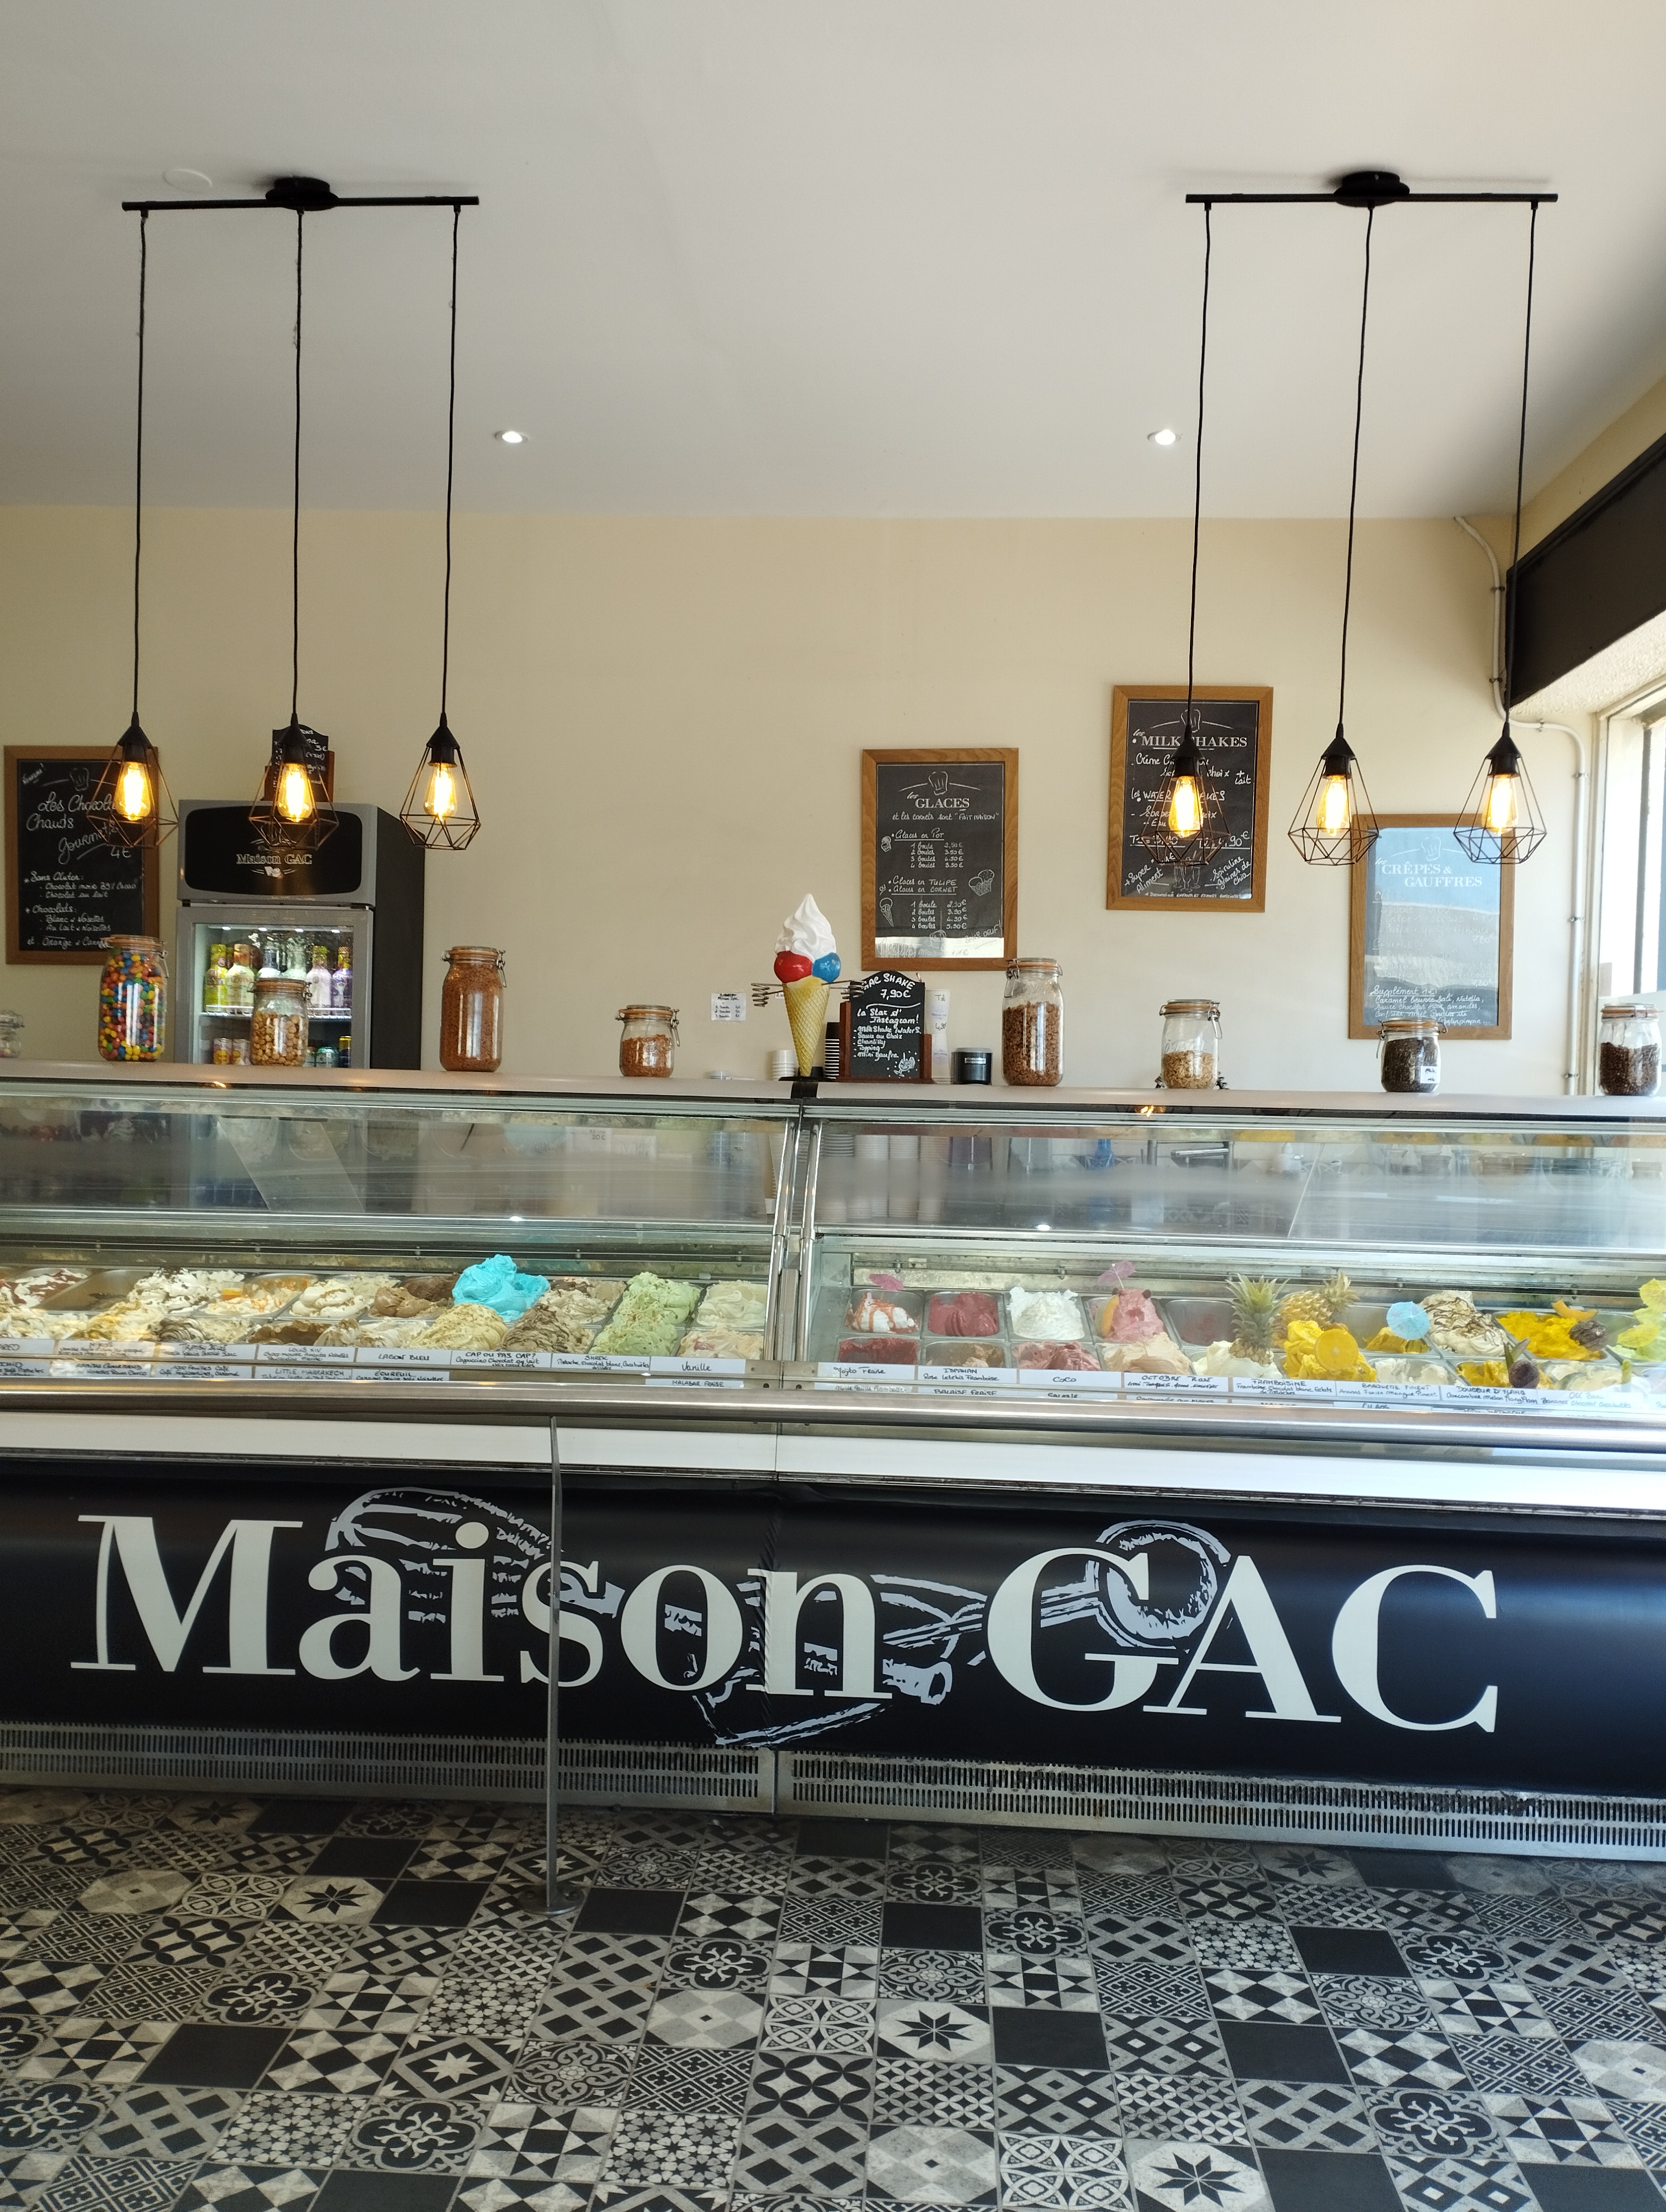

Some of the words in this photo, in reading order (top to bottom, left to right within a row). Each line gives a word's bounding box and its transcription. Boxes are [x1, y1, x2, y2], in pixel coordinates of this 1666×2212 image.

[1142, 736, 1181, 747] MILK
[1192, 737, 1247, 747] HAKES
[915, 798, 970, 808] GLACES
[27, 813, 74, 831] Chauds
[895, 829, 917, 839] Glaces
[236, 853, 281, 864] Maison
[284, 854, 312, 864] GAC
[1382, 861, 1441, 874] CRÊPES
[1443, 866, 1452, 874] &
[1405, 876, 1483, 887] GAUFFRES
[883, 973, 915, 990] SHAKE
[870, 1008, 888, 1017] Star
[682, 1361, 712, 1371] Vanille
[71, 1515, 893, 1700] Maison
[988, 1547, 1497, 1732] GAC
